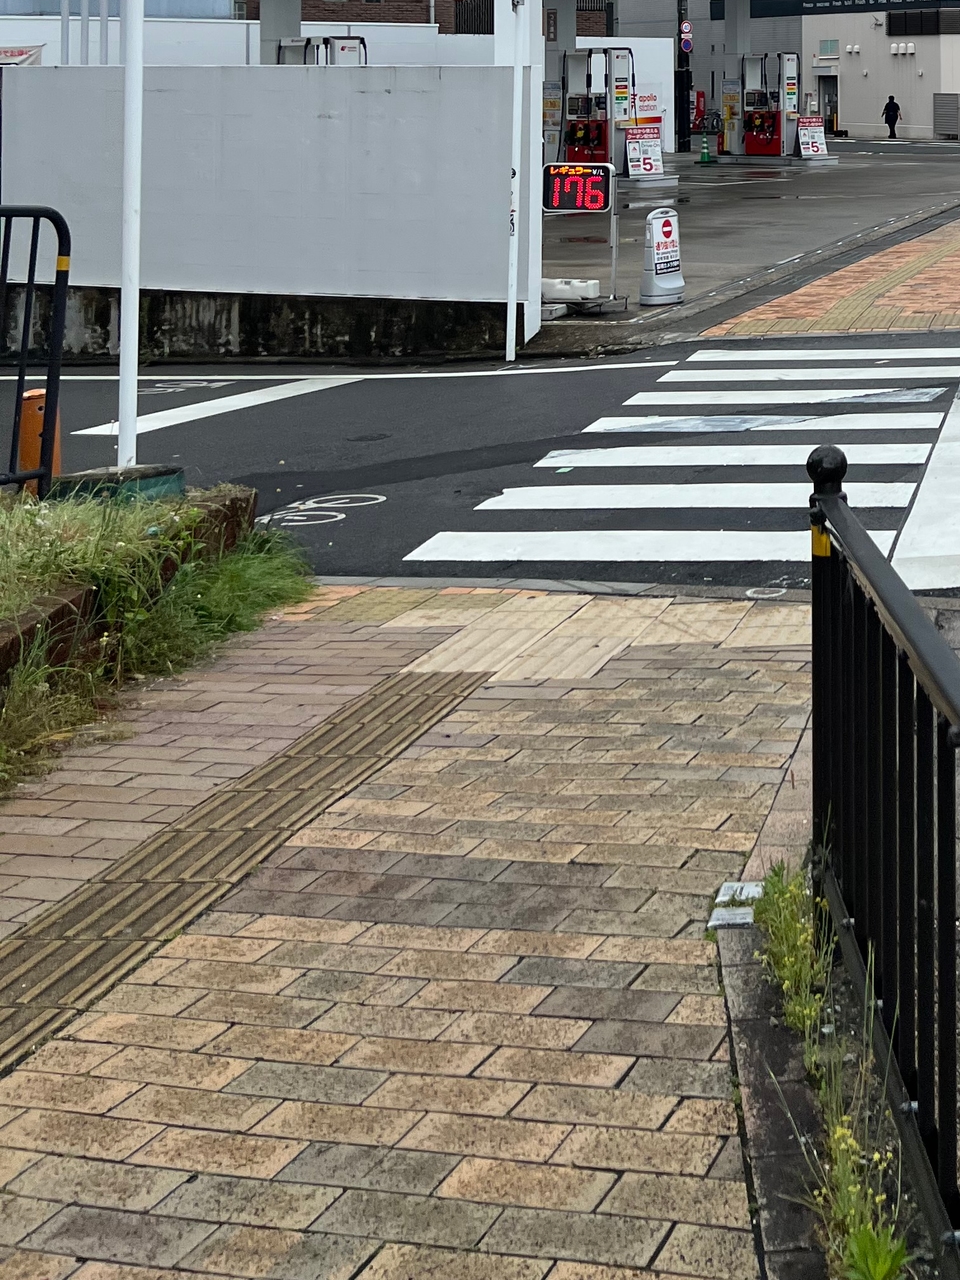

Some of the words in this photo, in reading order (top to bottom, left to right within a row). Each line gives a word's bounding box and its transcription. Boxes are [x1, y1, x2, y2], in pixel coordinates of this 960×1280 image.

[638, 93, 657, 103] apollo
[811, 141, 820, 153] 5
[550, 166, 592, 174] レギュラー
[643, 157, 654, 172] 5
[552, 176, 604, 209] 176
